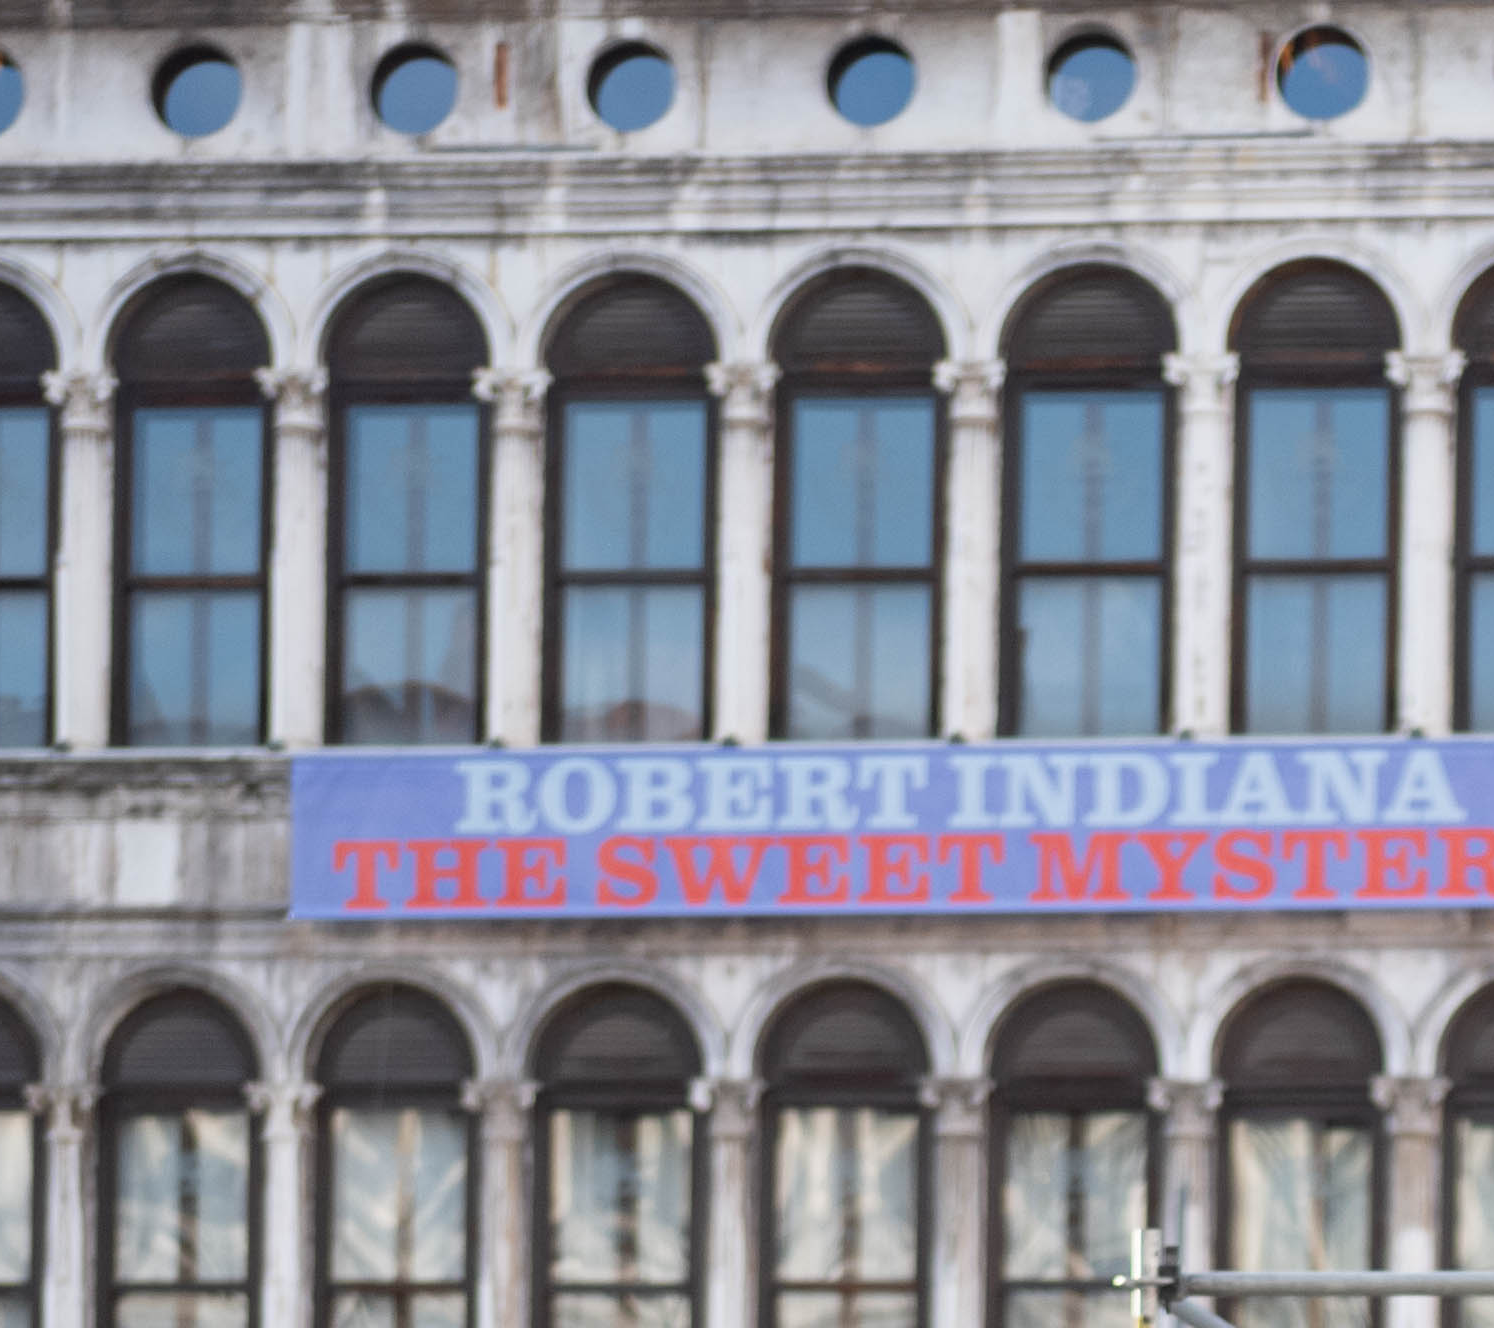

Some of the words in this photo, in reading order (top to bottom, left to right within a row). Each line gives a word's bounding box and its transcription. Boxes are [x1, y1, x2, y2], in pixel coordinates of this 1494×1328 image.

[456, 757, 928, 834] ROBERT
[946, 749, 1468, 829] INDIANA
[333, 837, 569, 909] THE
[595, 833, 1005, 906] SWEET
